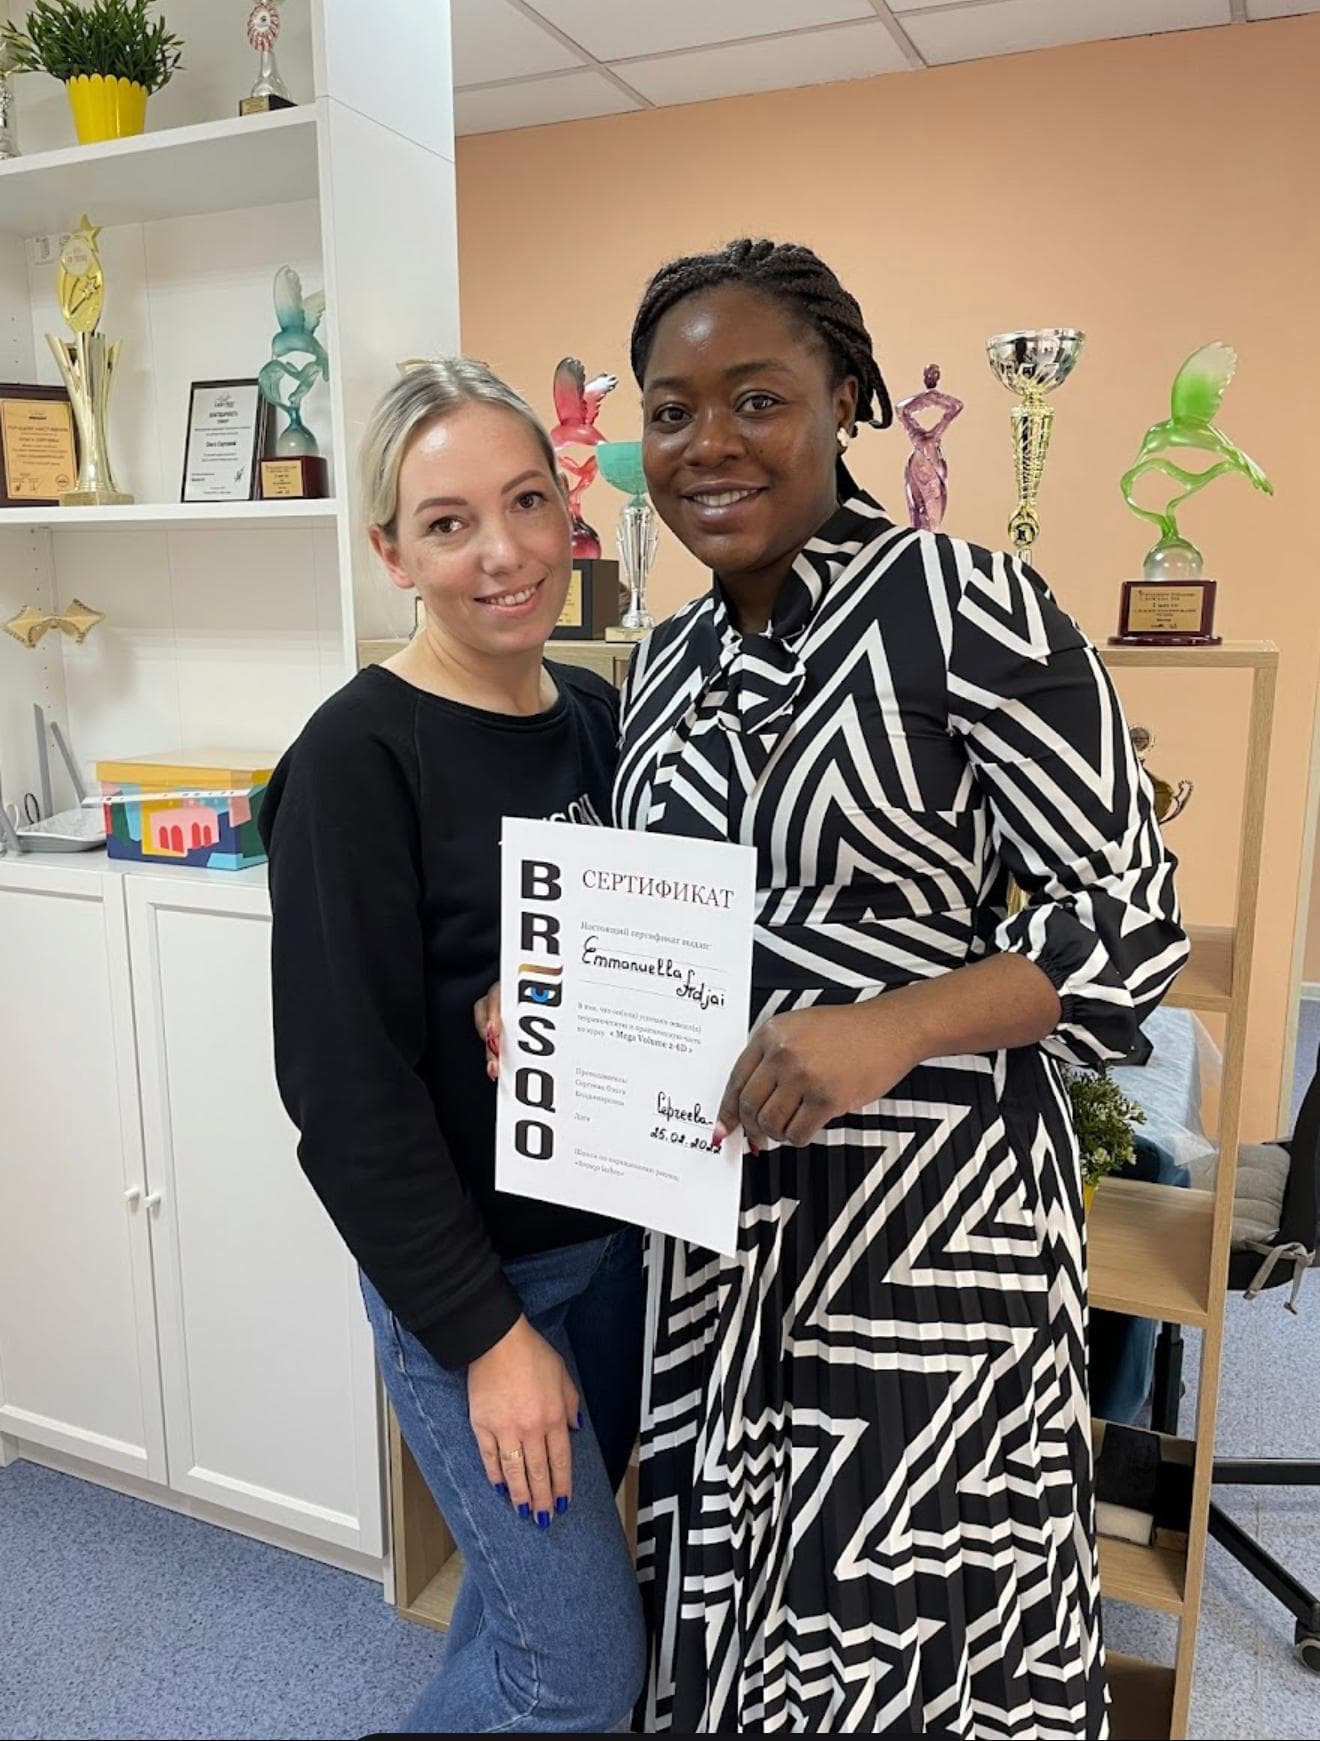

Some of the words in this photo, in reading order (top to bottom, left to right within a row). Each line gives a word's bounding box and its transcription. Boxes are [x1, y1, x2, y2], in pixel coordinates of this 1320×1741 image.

[582, 869, 735, 909] СЕРТИФИКАТ
[581, 935, 682, 979] Emmanuella
[616, 1029, 636, 1042] Mega
[637, 1034, 667, 1049] Volume
